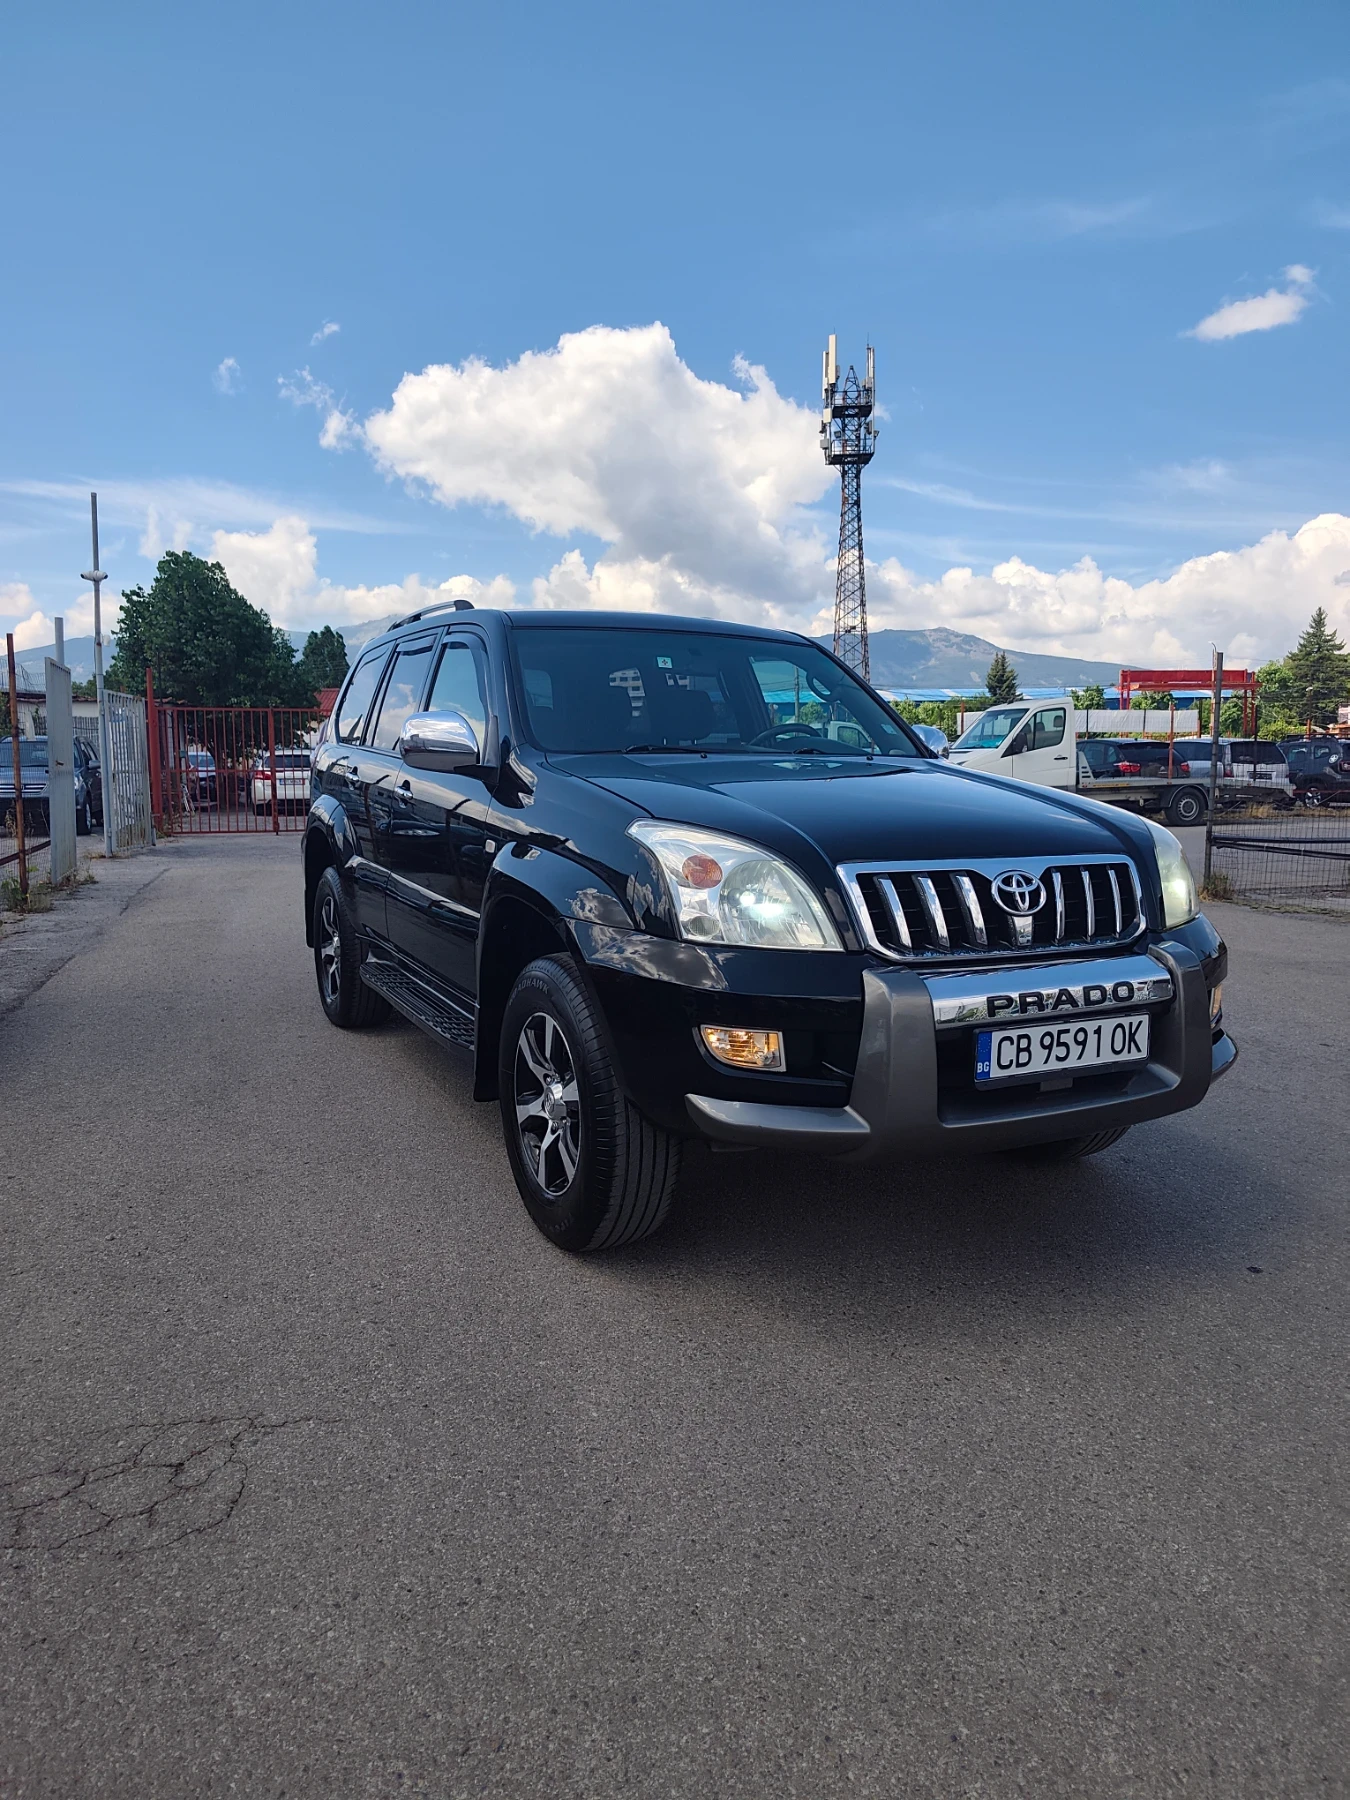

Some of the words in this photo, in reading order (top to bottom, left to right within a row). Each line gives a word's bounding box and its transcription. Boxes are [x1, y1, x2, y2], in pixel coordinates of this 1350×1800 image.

[986, 981, 1135, 1017] PRADO
[996, 1034, 1032, 1070] CB
[1039, 1025, 1103, 1064] 9591
[1110, 1020, 1143, 1055] OK
[977, 1062, 990, 1073] BG
